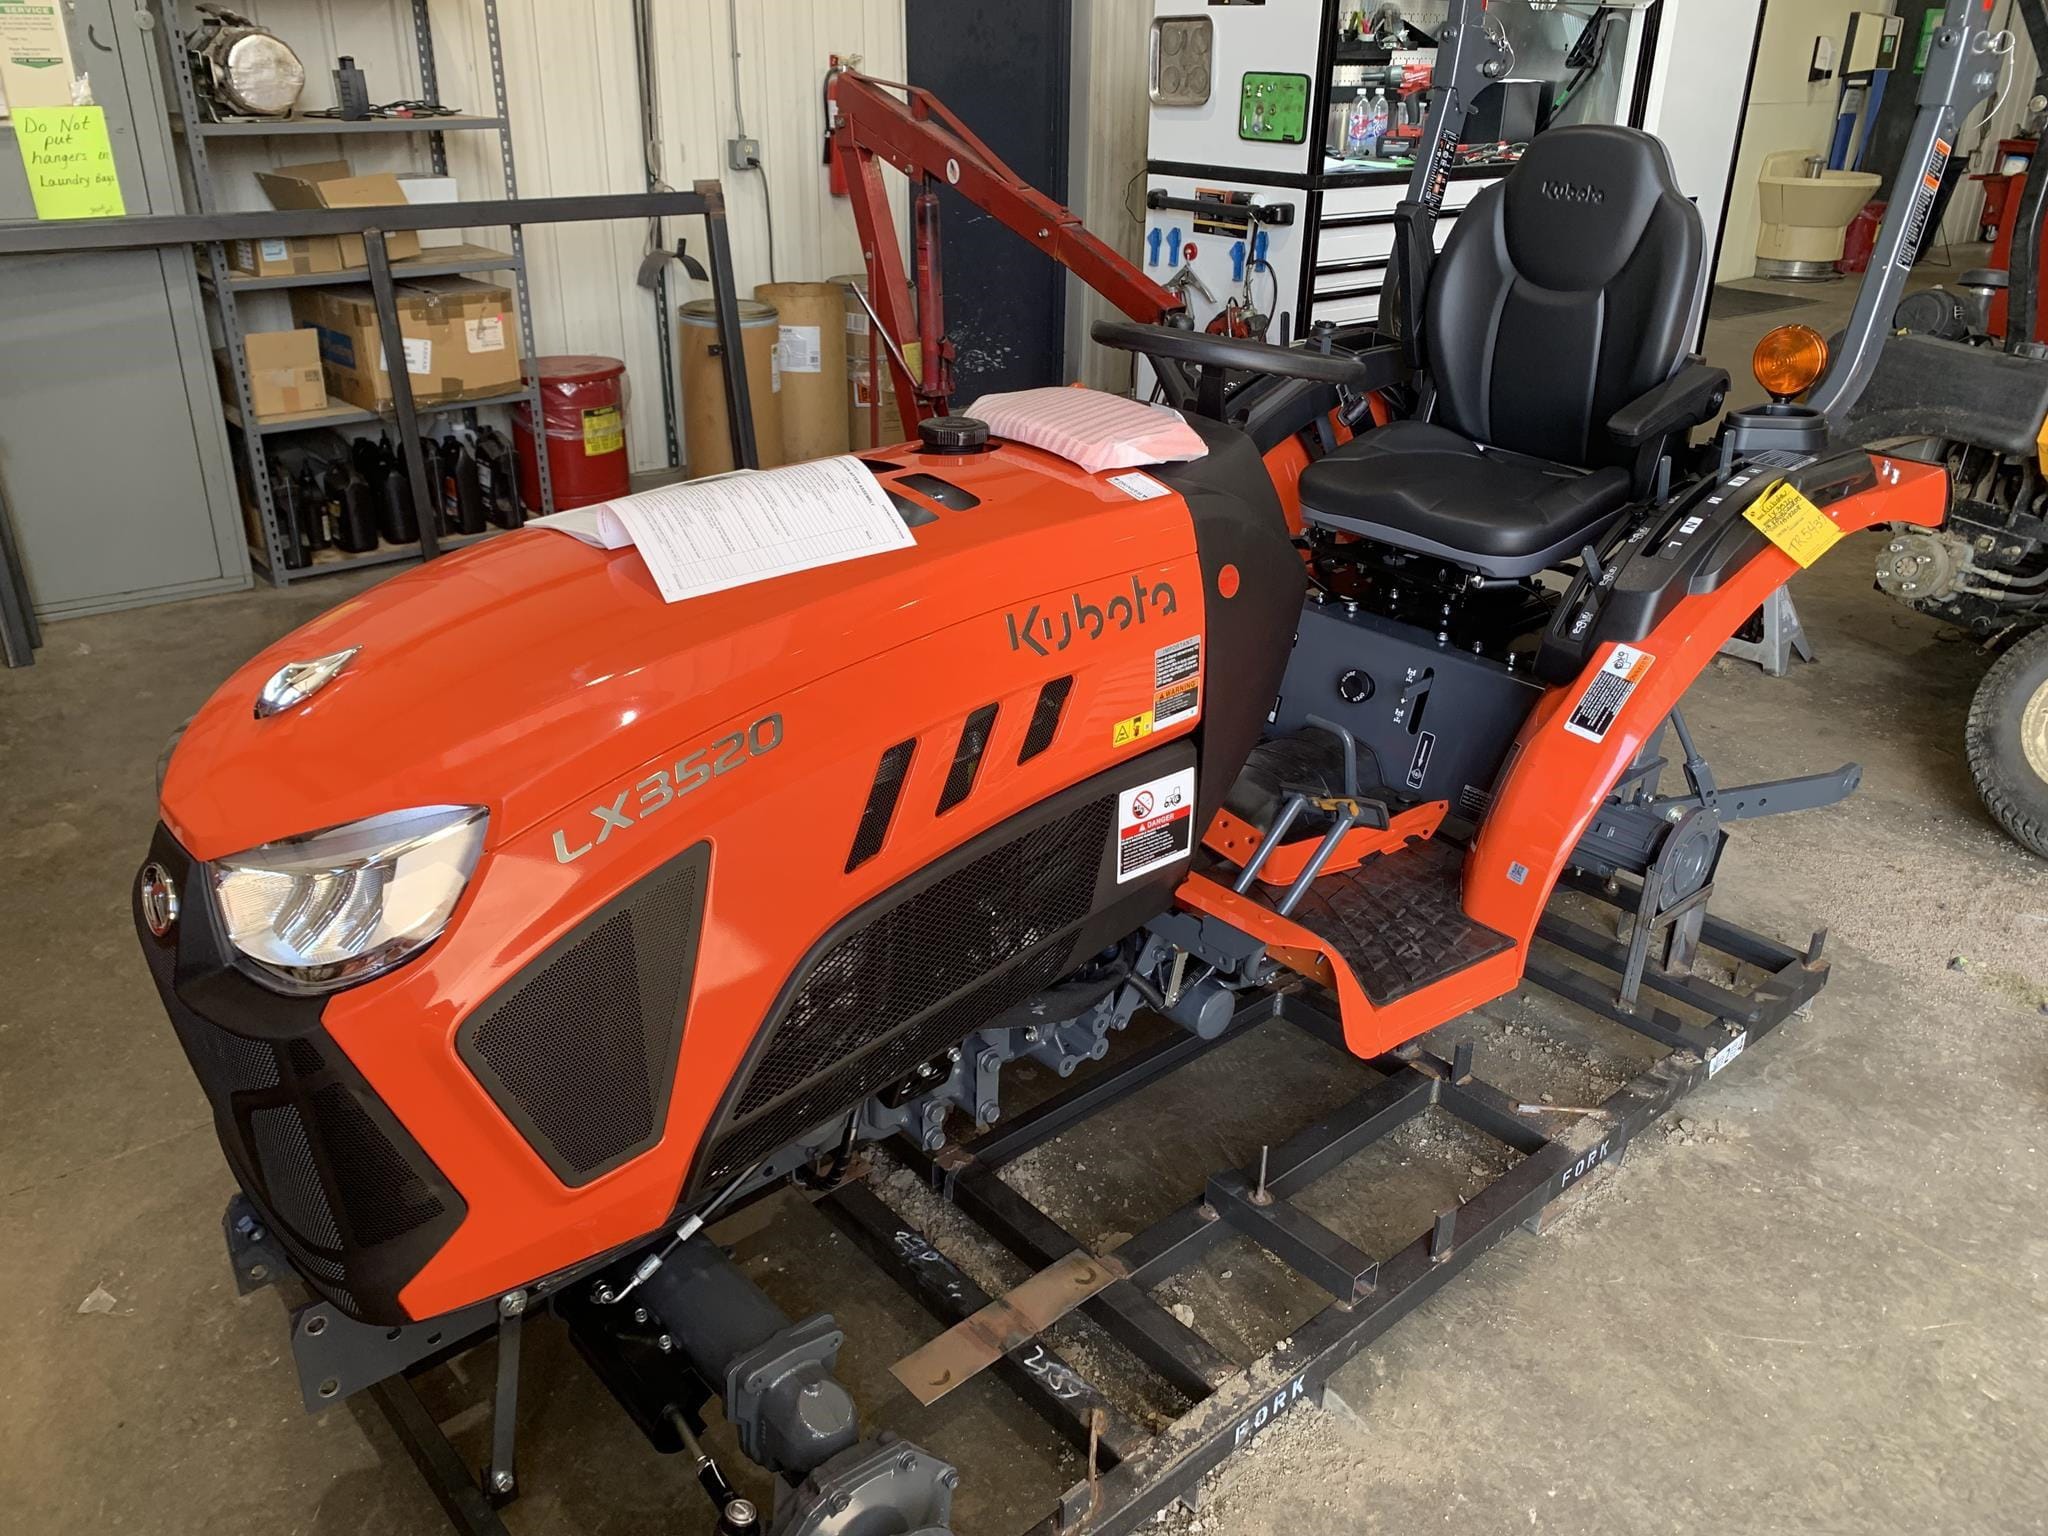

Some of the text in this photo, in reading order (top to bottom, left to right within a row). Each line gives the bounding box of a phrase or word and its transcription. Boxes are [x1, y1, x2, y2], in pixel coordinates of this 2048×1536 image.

[25, 114, 90, 133] Do Not
[44, 134, 73, 150] put
[32, 151, 87, 169] hangers
[40, 174, 90, 188] Laundry
[1541, 181, 1605, 204] Kubota
[1006, 575, 1177, 656] Kubota
[1165, 680, 1196, 698] WARNING
[552, 711, 784, 864] LX3520
[1146, 812, 1175, 829] DANGER
[1560, 1139, 1610, 1188] FORK
[1234, 1374, 1305, 1446] FORK
